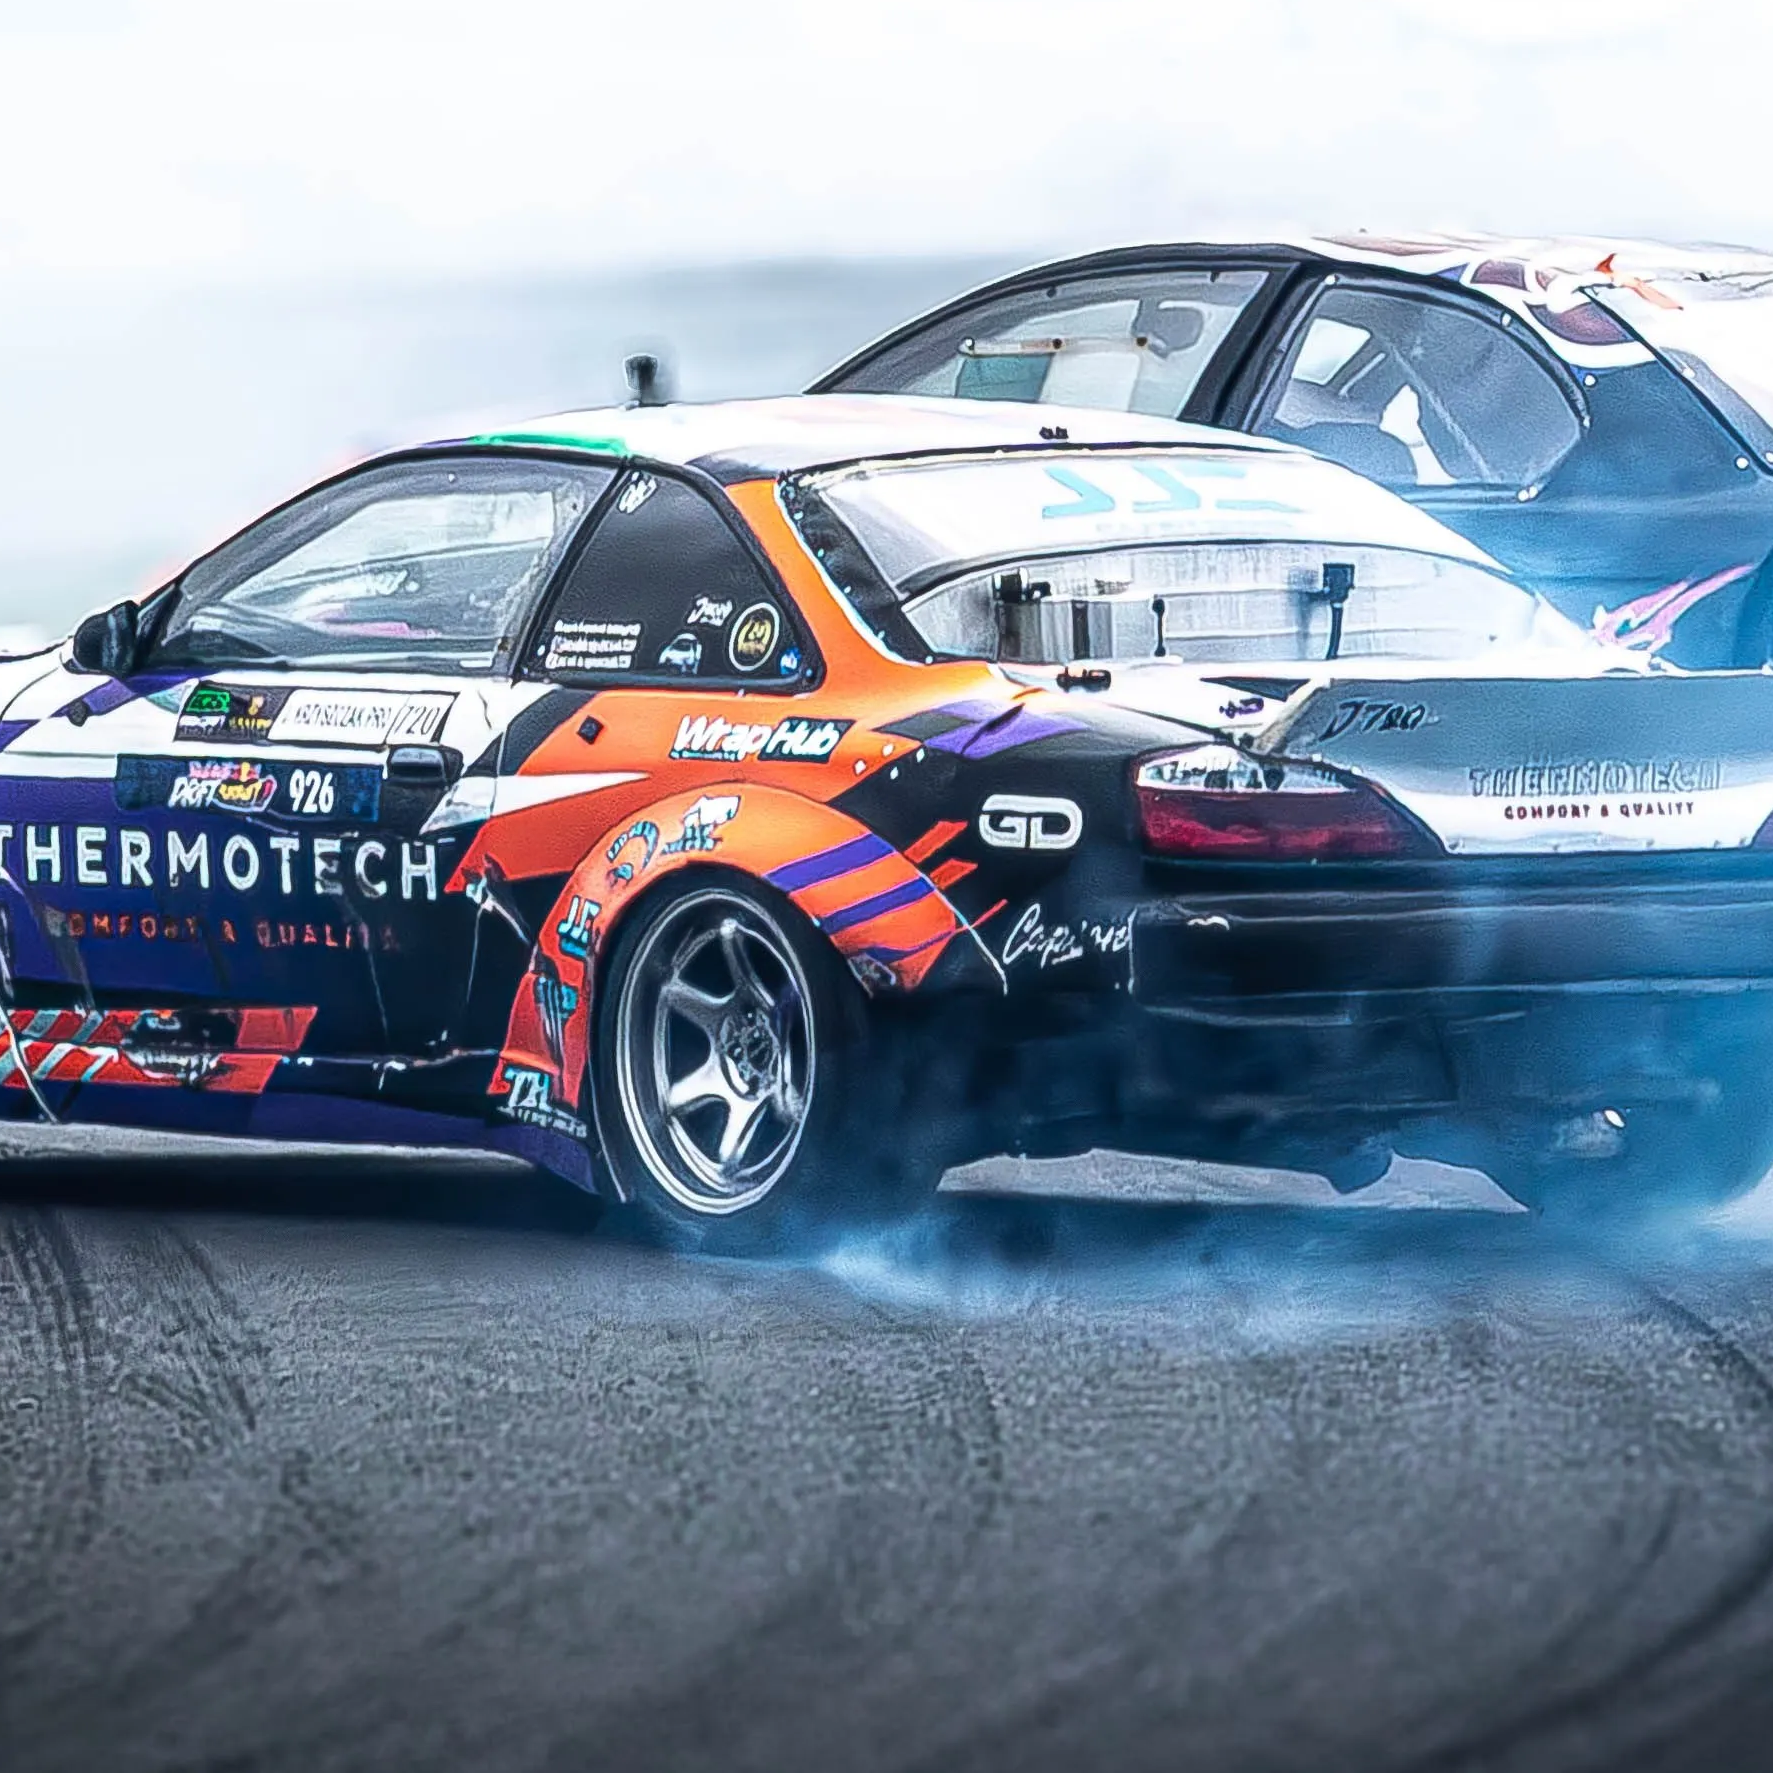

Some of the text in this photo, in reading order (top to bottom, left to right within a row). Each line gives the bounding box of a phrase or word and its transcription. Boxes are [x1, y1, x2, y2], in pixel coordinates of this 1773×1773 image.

[393, 704, 441, 736] 720
[289, 769, 335, 814] 926
[1468, 759, 1722, 798] THERMOTECH
[978, 792, 1084, 851] GD
[1619, 800, 1695, 818] QUALITY
